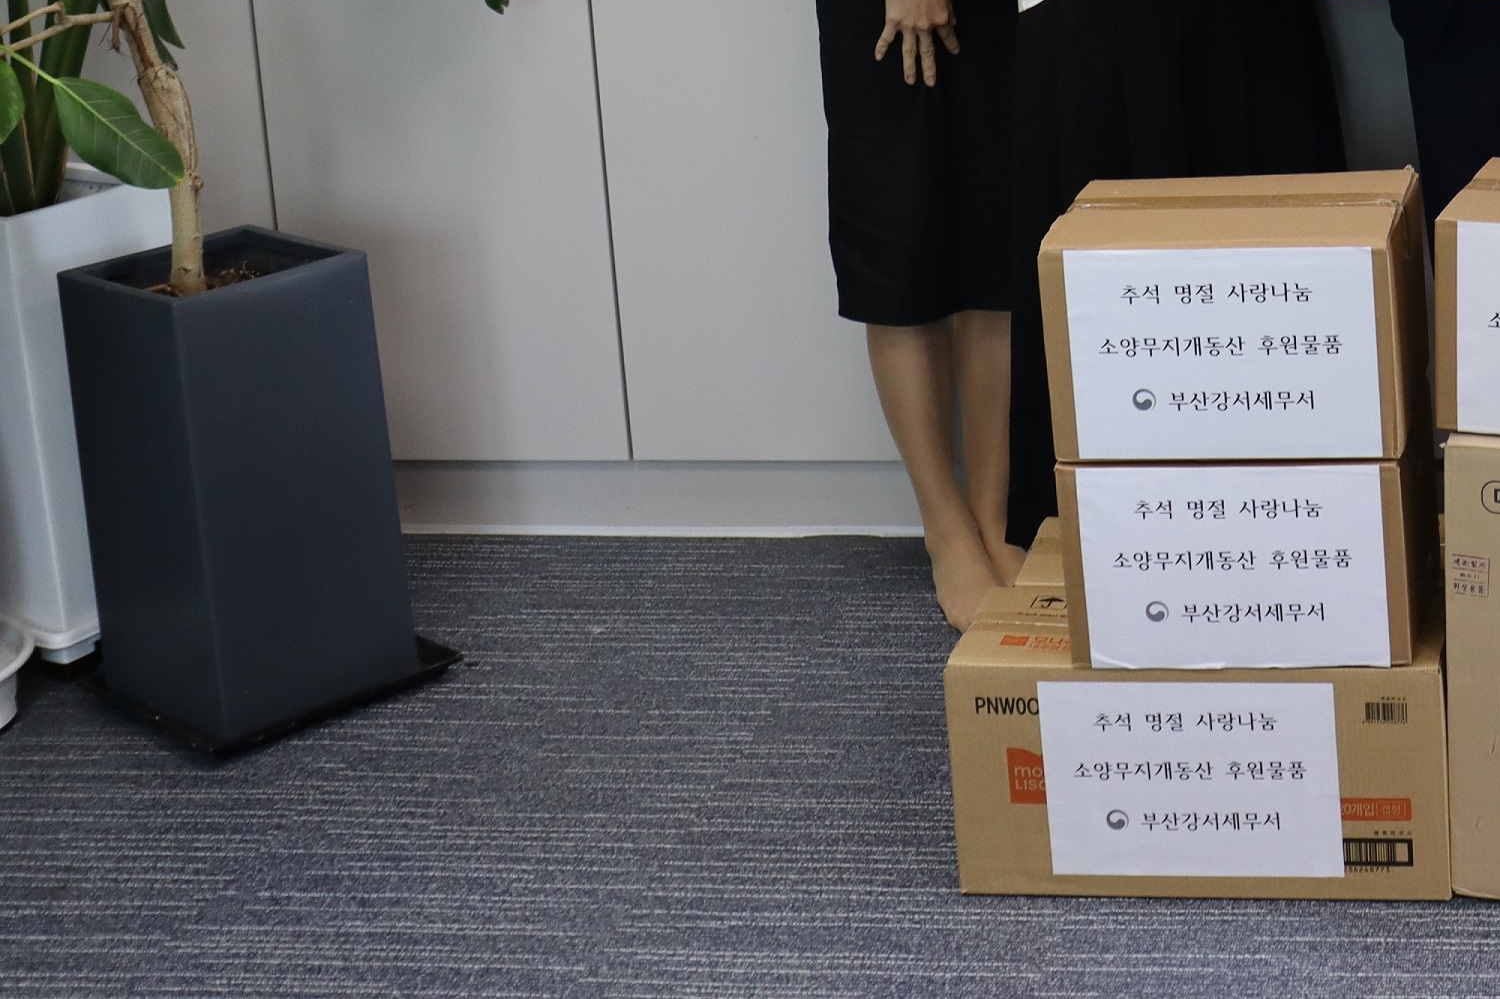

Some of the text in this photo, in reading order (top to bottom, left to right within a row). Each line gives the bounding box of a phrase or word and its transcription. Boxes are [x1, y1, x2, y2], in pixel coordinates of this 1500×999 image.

[1120, 282, 1313, 305] 추석 명절 사랑나눔
[1098, 335, 1344, 358] 소양무지개동산 후원물품
[1168, 389, 1315, 412] 부산강서세무서
[1134, 499, 1323, 520] 추석 명절 사랑나눔
[1112, 550, 1353, 572] 소양무지개동산 후원물품
[1181, 602, 1326, 624] 부산강서세무서
[1093, 712, 1278, 733] 추석 명절 사랑나눔
[1073, 761, 1308, 782] 소양무지개동산 후원물품
[1140, 811, 1282, 832] 부산강서세무서
